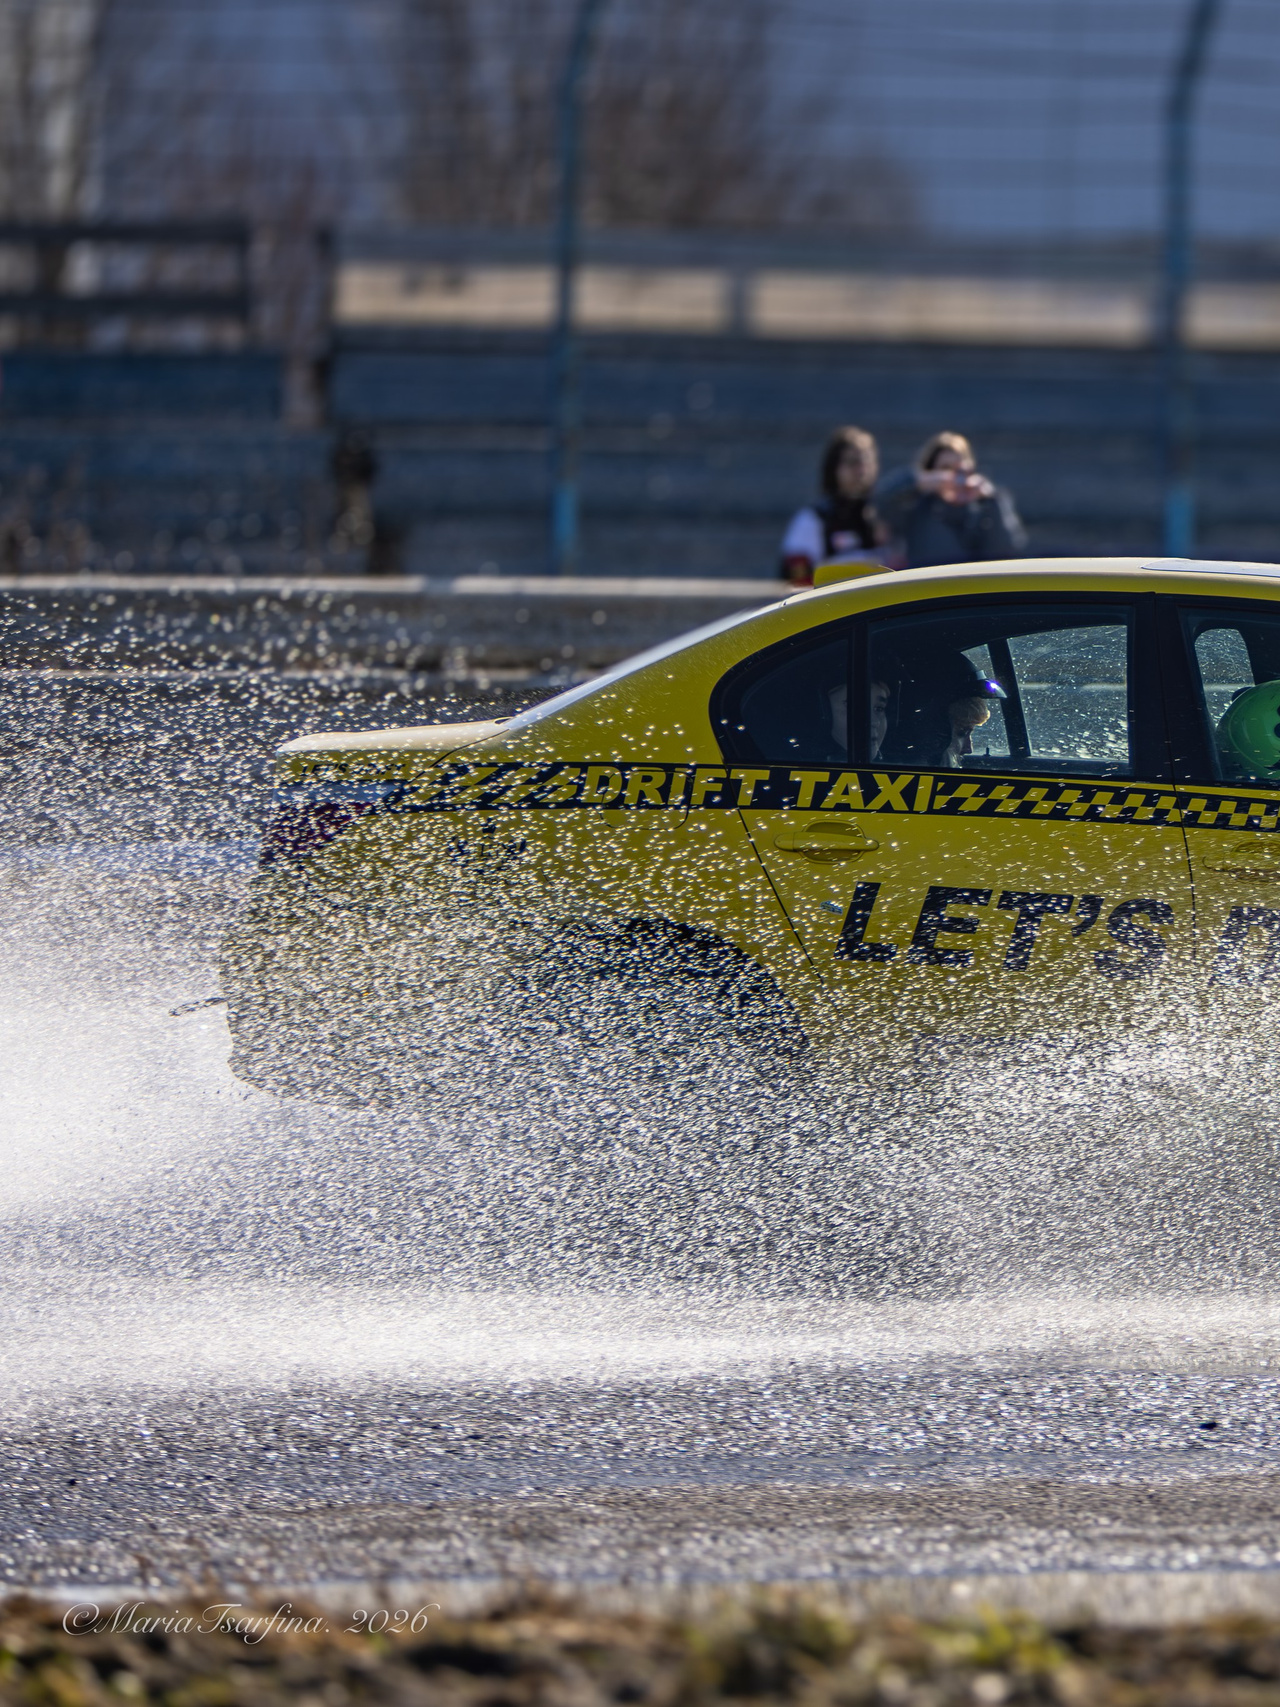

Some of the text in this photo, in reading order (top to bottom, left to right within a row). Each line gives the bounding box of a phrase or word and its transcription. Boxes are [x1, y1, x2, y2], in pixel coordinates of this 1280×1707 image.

[580, 766, 934, 811] DRIFT TAXI
[834, 881, 1174, 980] LET'S
